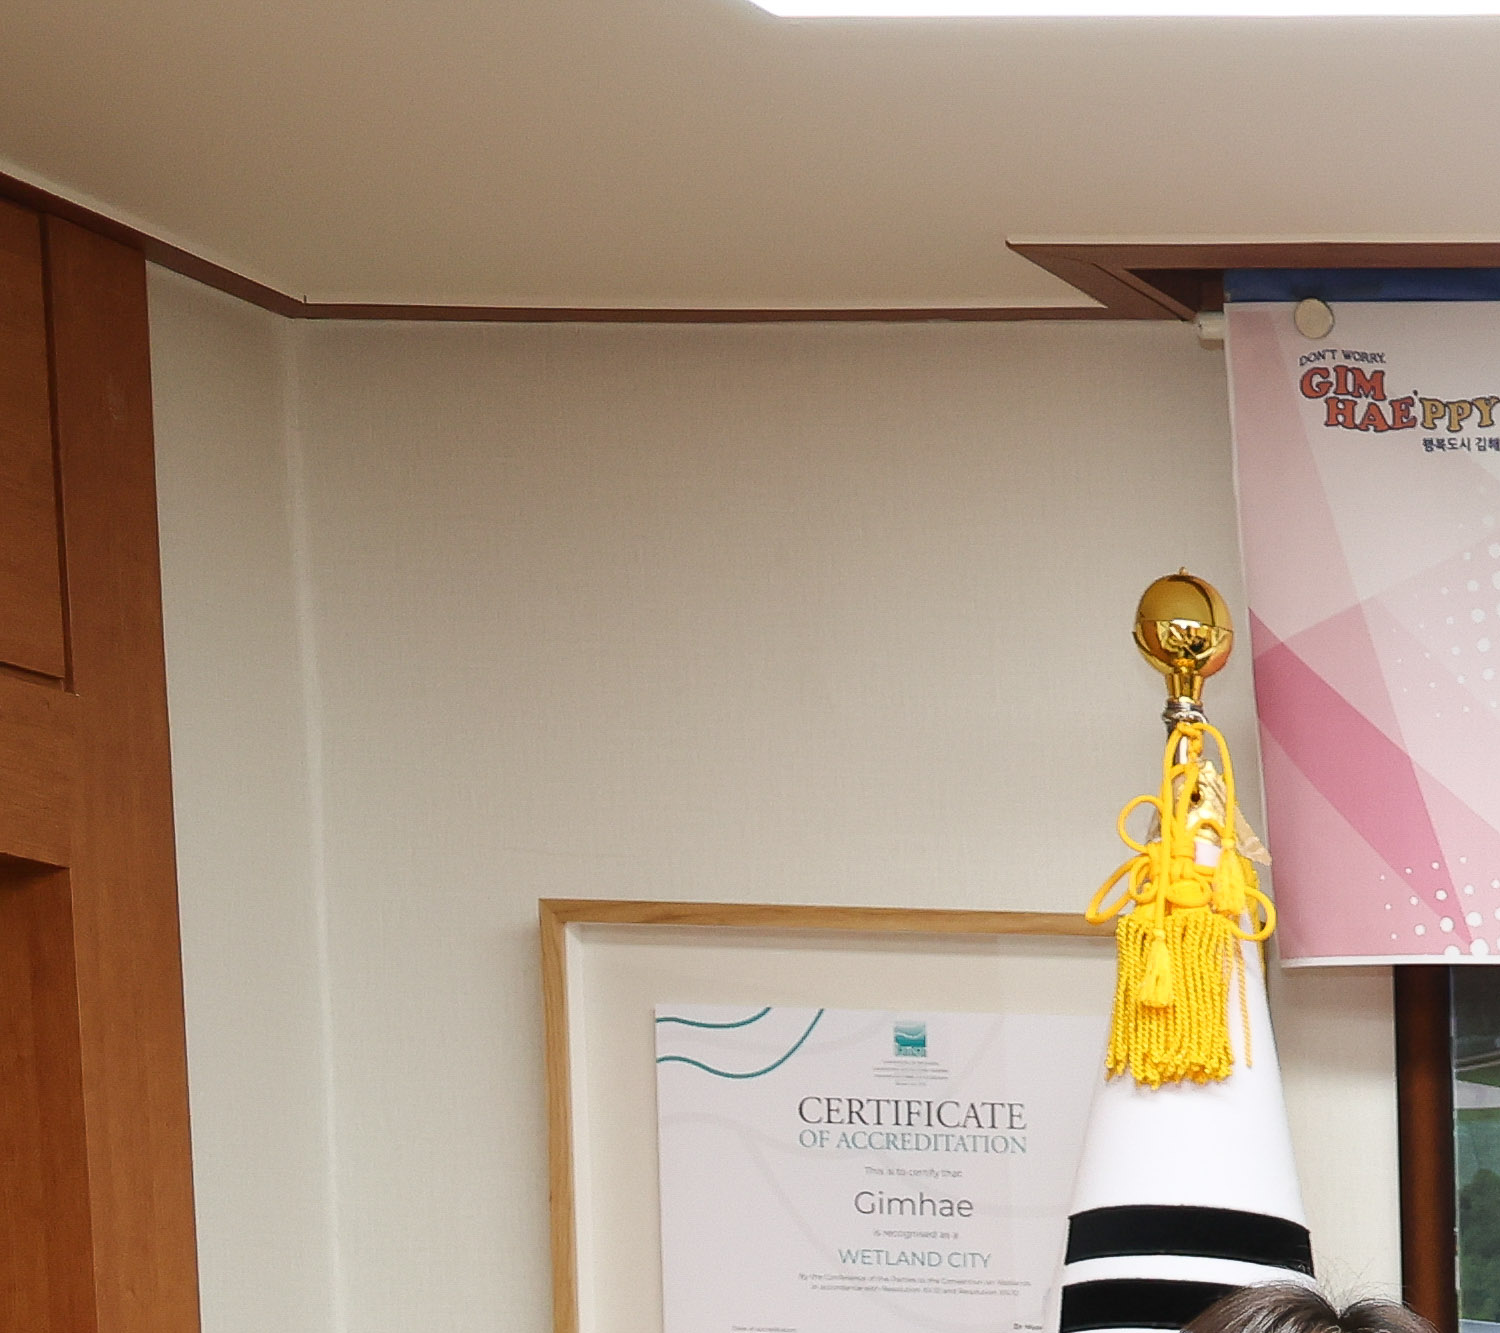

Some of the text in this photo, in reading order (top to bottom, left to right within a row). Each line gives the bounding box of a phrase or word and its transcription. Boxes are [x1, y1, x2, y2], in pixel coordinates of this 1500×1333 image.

[1300, 365, 1386, 401] GIM
[1423, 437, 1500, 451] 행복도시 김해
[798, 1096, 1028, 1130] CERTIFICATE
[799, 1129, 1027, 1154] OF ACCREDITATION
[854, 1191, 974, 1218] Gimhae
[838, 1248, 992, 1269] WETLAND CITY
